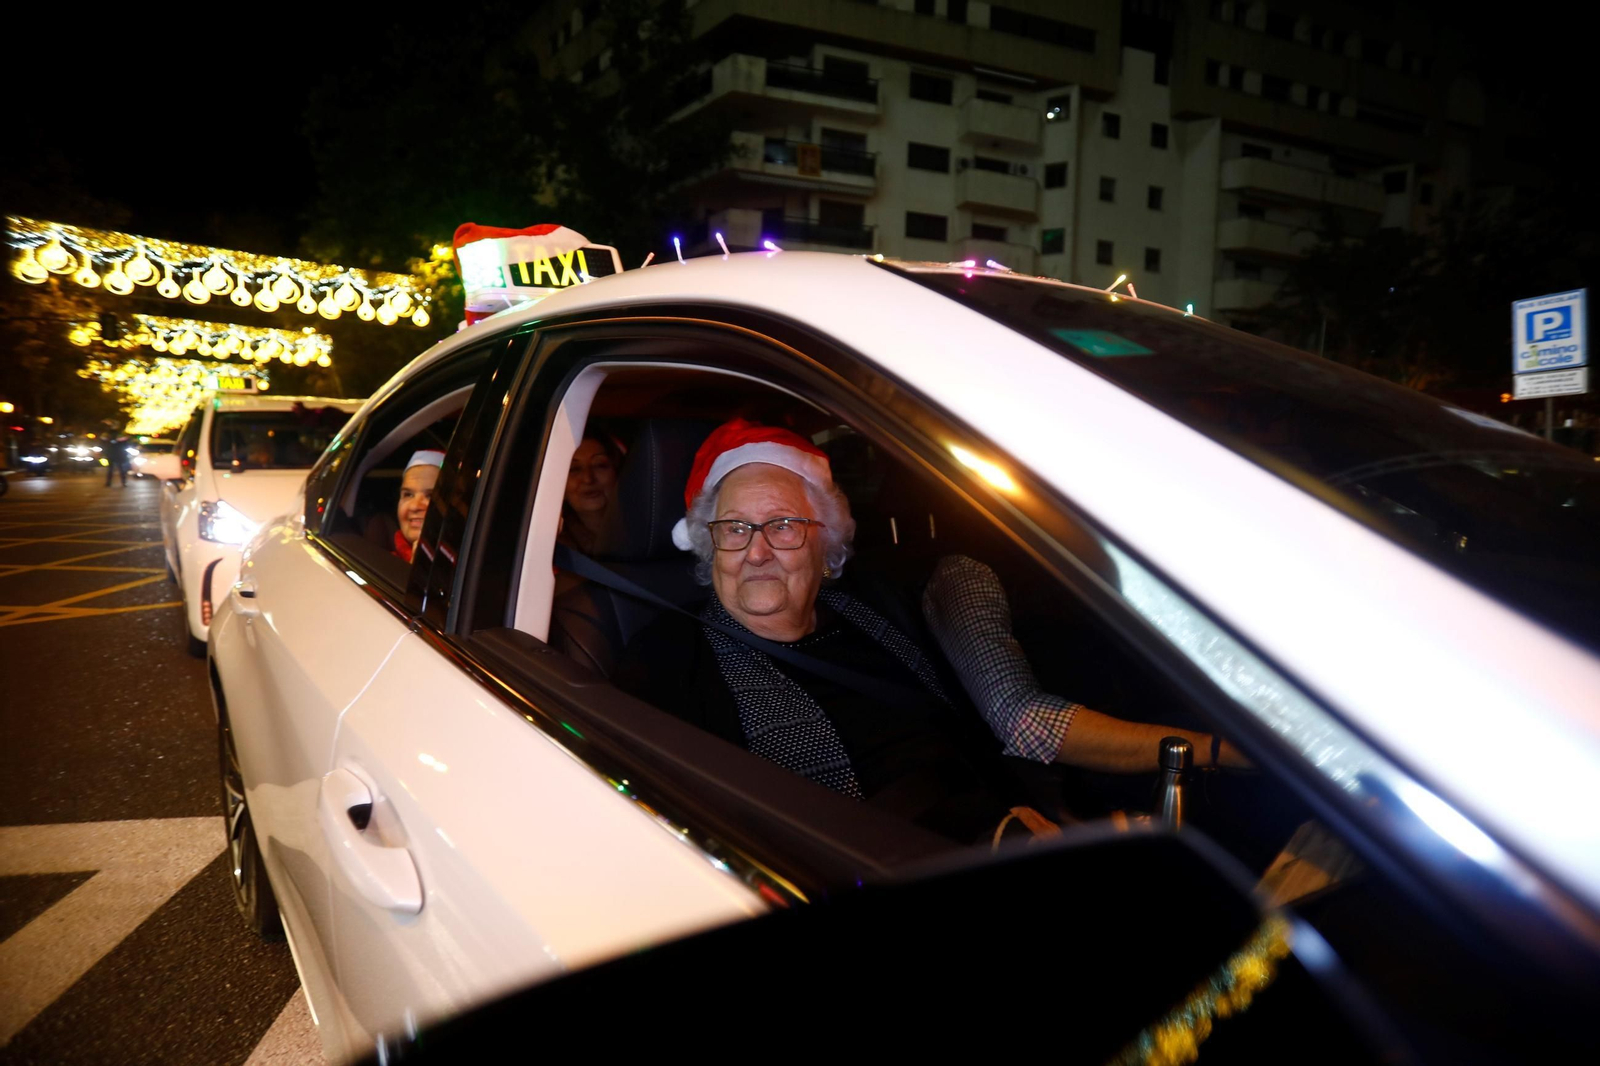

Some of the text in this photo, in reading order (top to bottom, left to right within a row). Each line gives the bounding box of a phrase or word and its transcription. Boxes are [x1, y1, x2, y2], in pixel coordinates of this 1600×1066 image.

[514, 246, 590, 286] TAXI
[1533, 311, 1563, 340] P
[219, 376, 245, 389] TAXI
